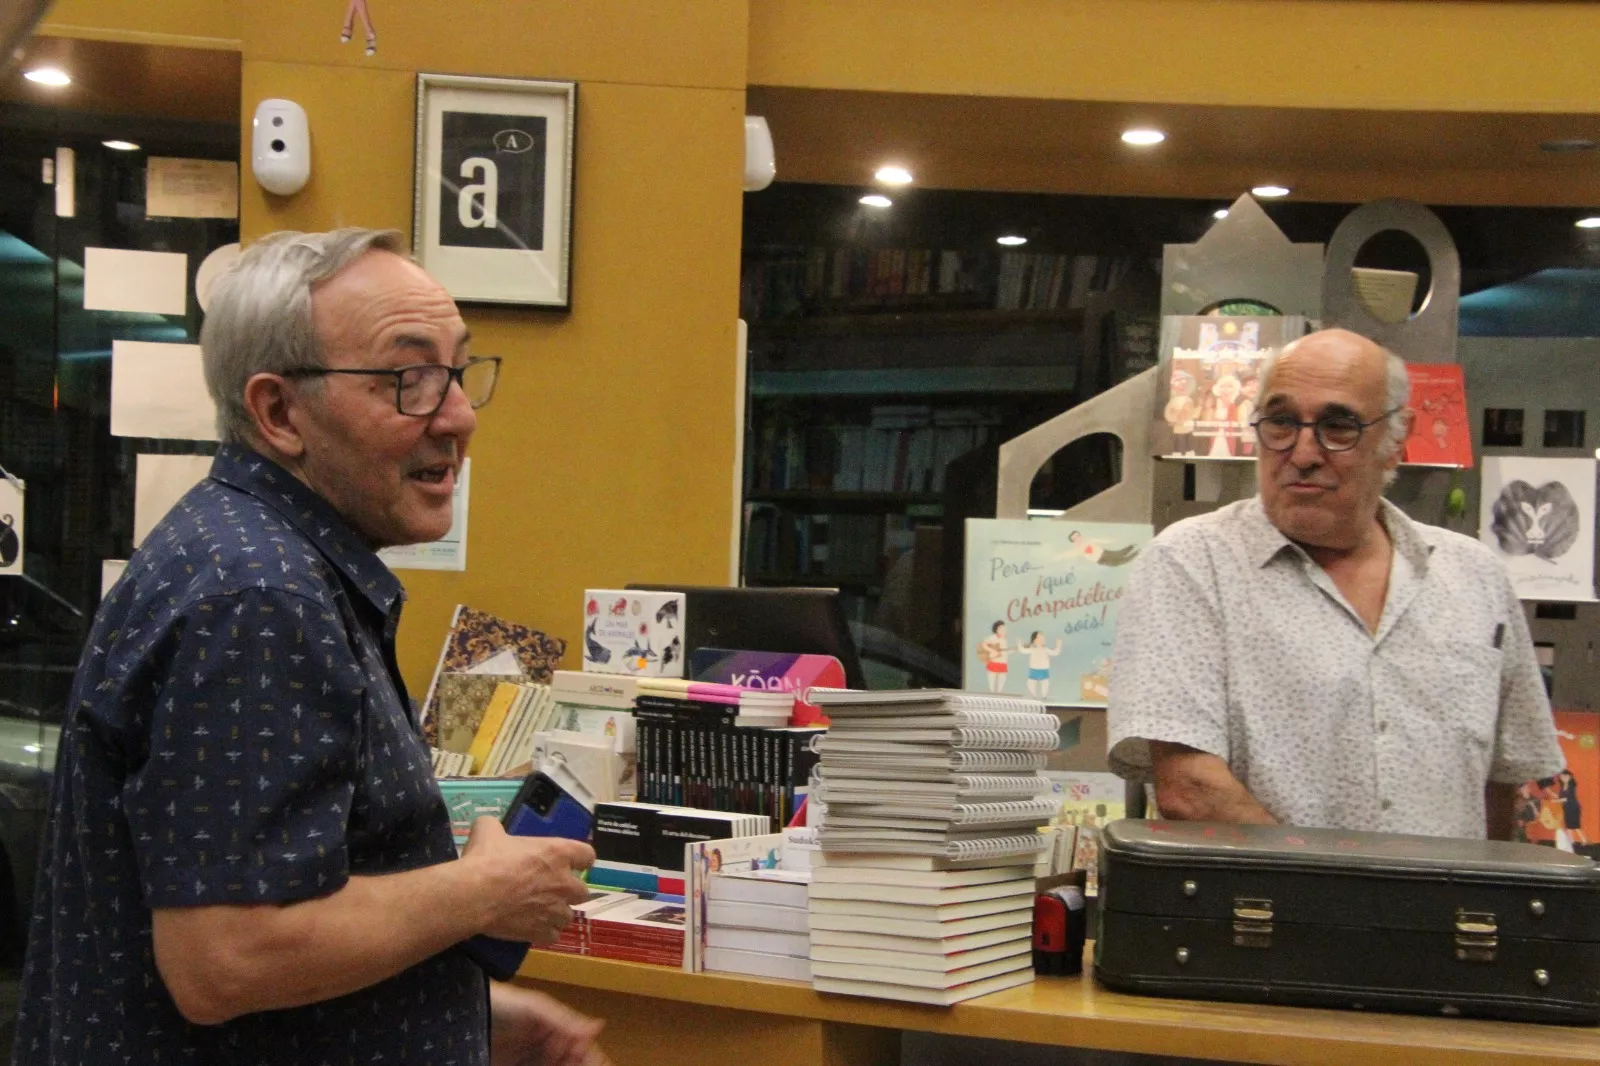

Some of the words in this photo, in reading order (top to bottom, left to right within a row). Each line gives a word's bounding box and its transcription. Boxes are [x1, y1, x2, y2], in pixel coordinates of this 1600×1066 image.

[506, 134, 518, 149] A
[458, 157, 498, 229] a
[990, 557, 1044, 582] Pero
